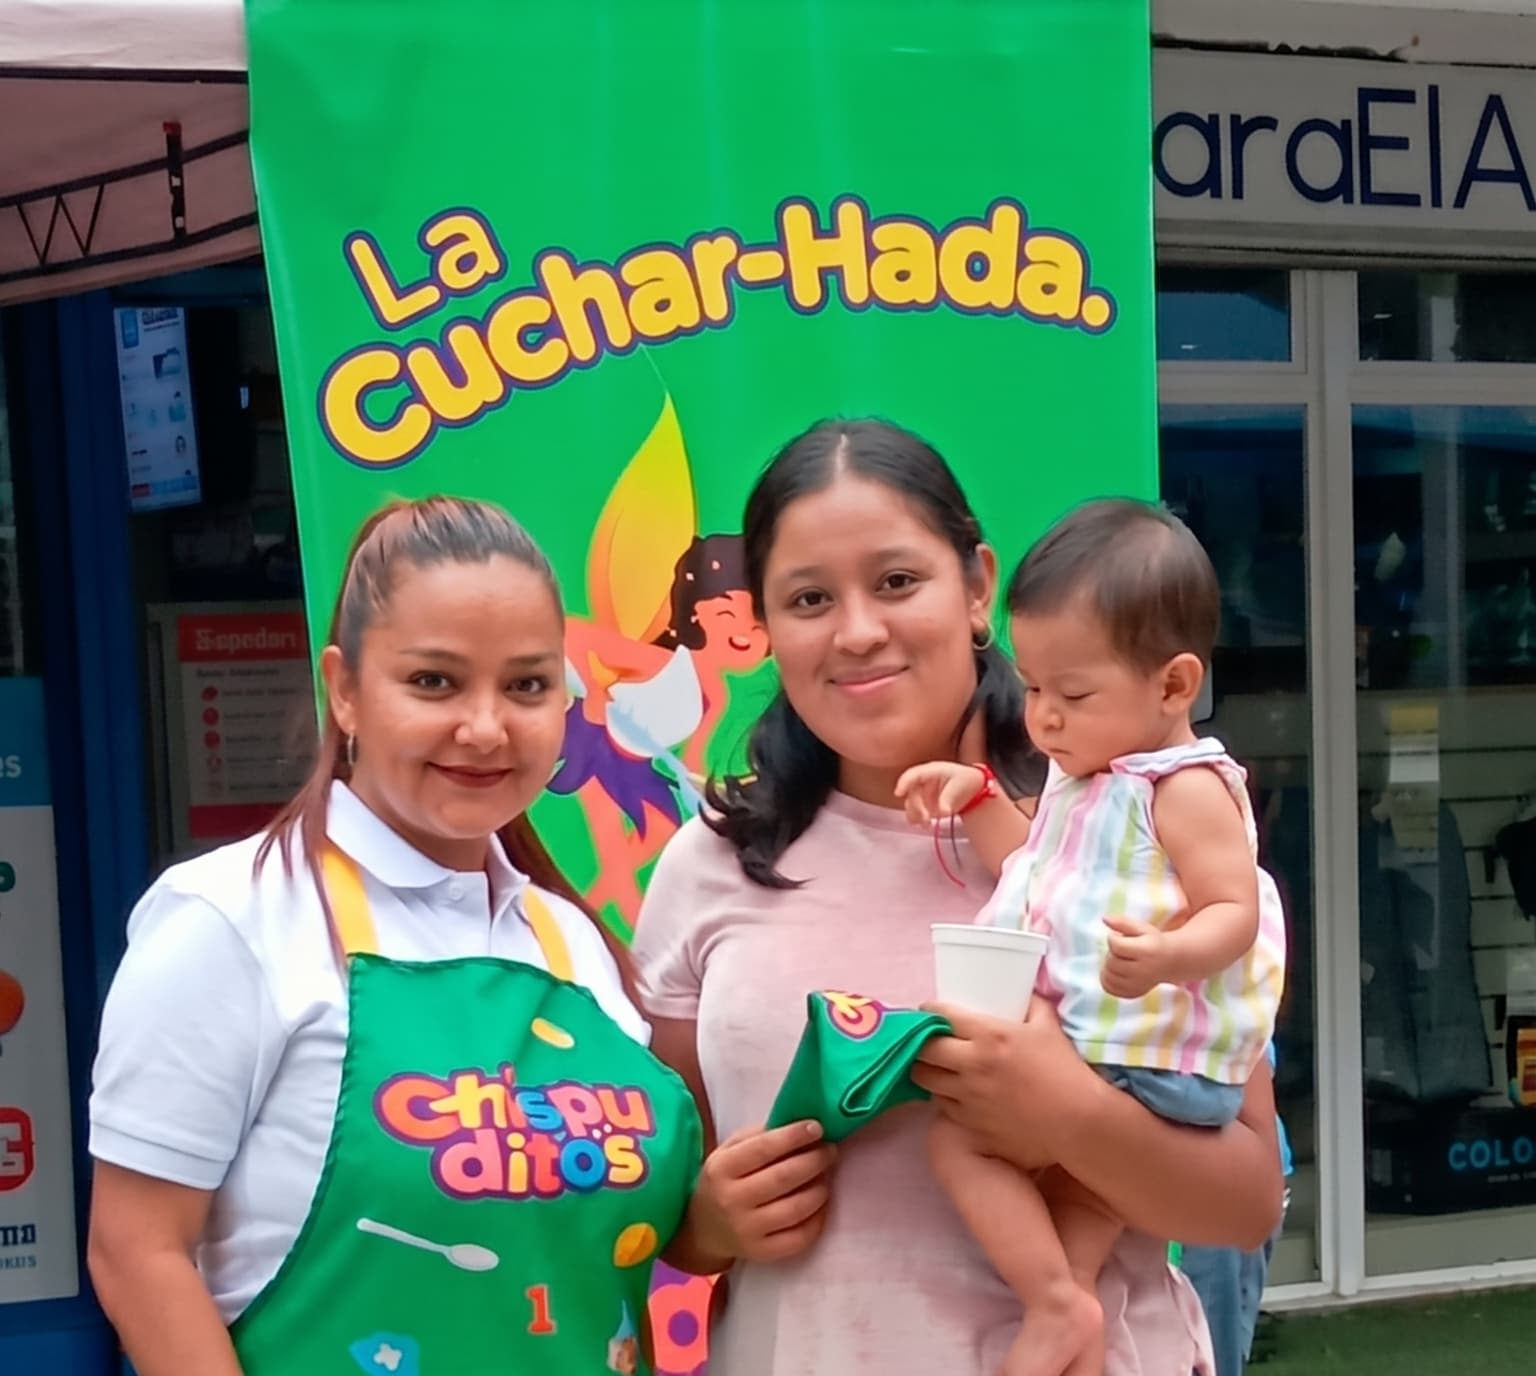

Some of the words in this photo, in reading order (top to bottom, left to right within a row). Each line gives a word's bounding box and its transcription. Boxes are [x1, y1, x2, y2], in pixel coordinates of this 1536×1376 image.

[346, 209, 504, 329] La
[320, 196, 1114, 469] Cuchar-Hada.
[375, 1062, 655, 1143] Chispu
[433, 1124, 647, 1198] ditos
[525, 1283, 557, 1335] 1
